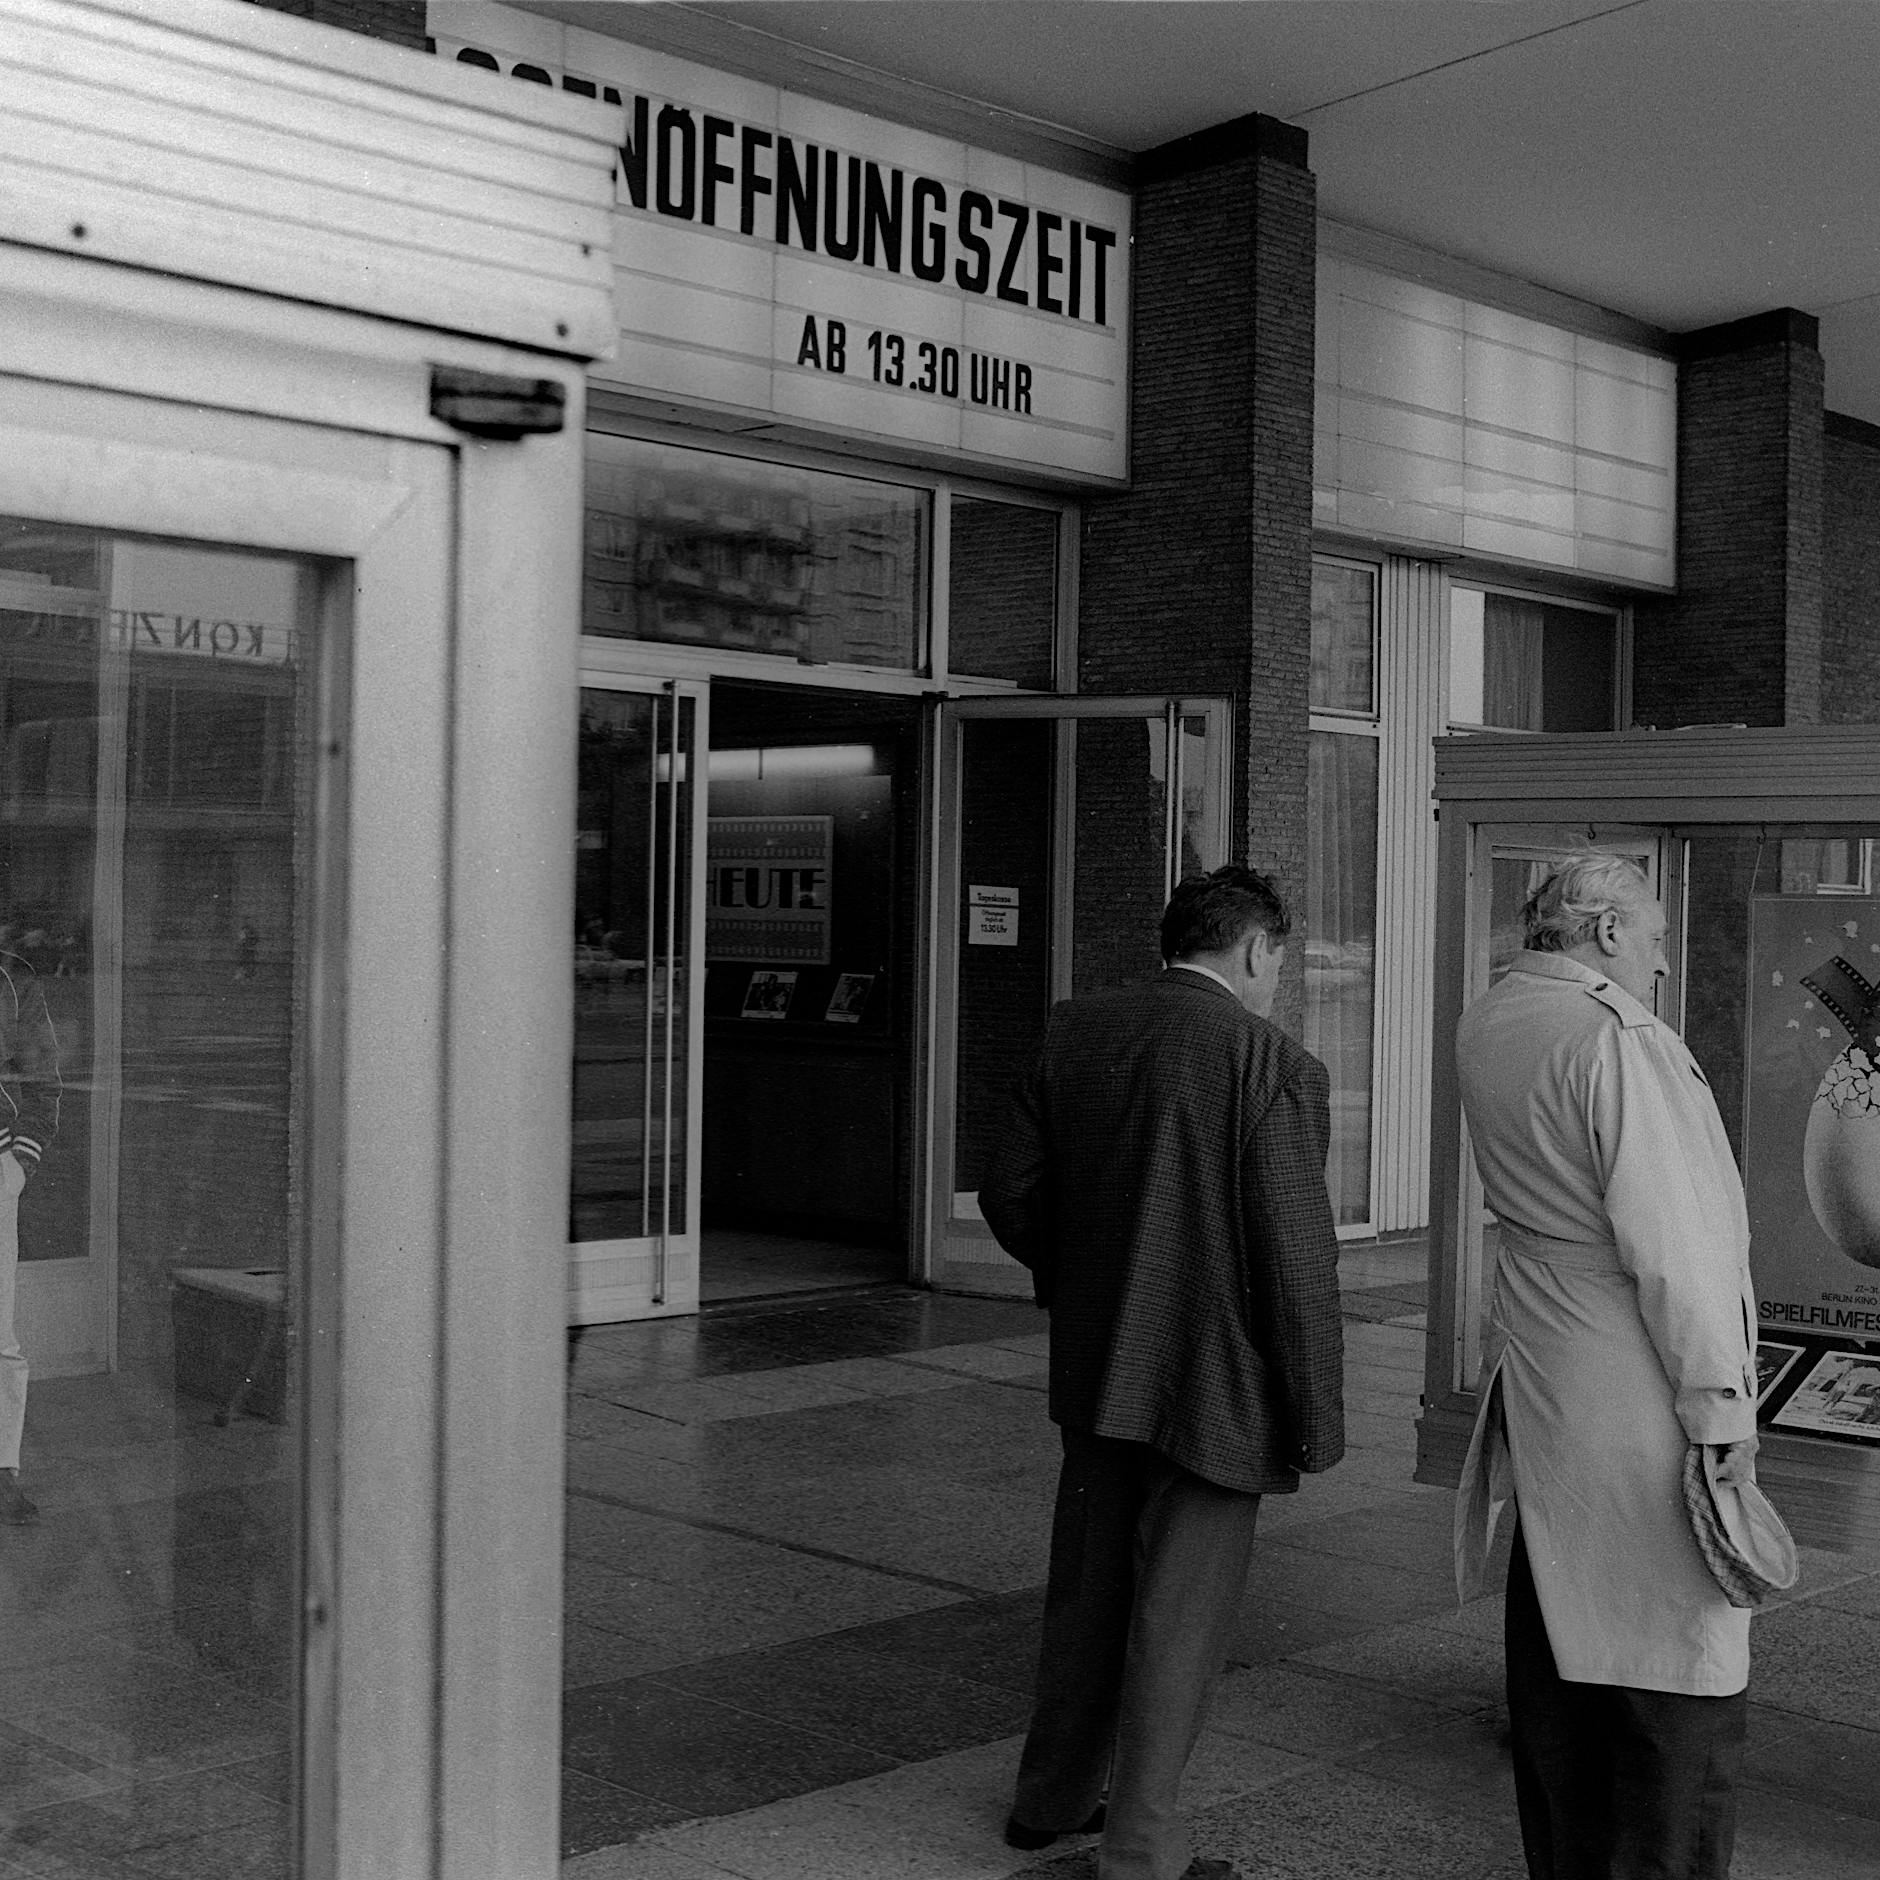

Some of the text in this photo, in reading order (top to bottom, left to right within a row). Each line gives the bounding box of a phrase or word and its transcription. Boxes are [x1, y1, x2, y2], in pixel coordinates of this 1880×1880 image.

[426, 38, 1116, 325] NÖFFNUNGSZEIT
[798, 314, 1033, 415] AB 13.30 UHR
[1821, 1292, 1878, 1306] BERLIN KINO
